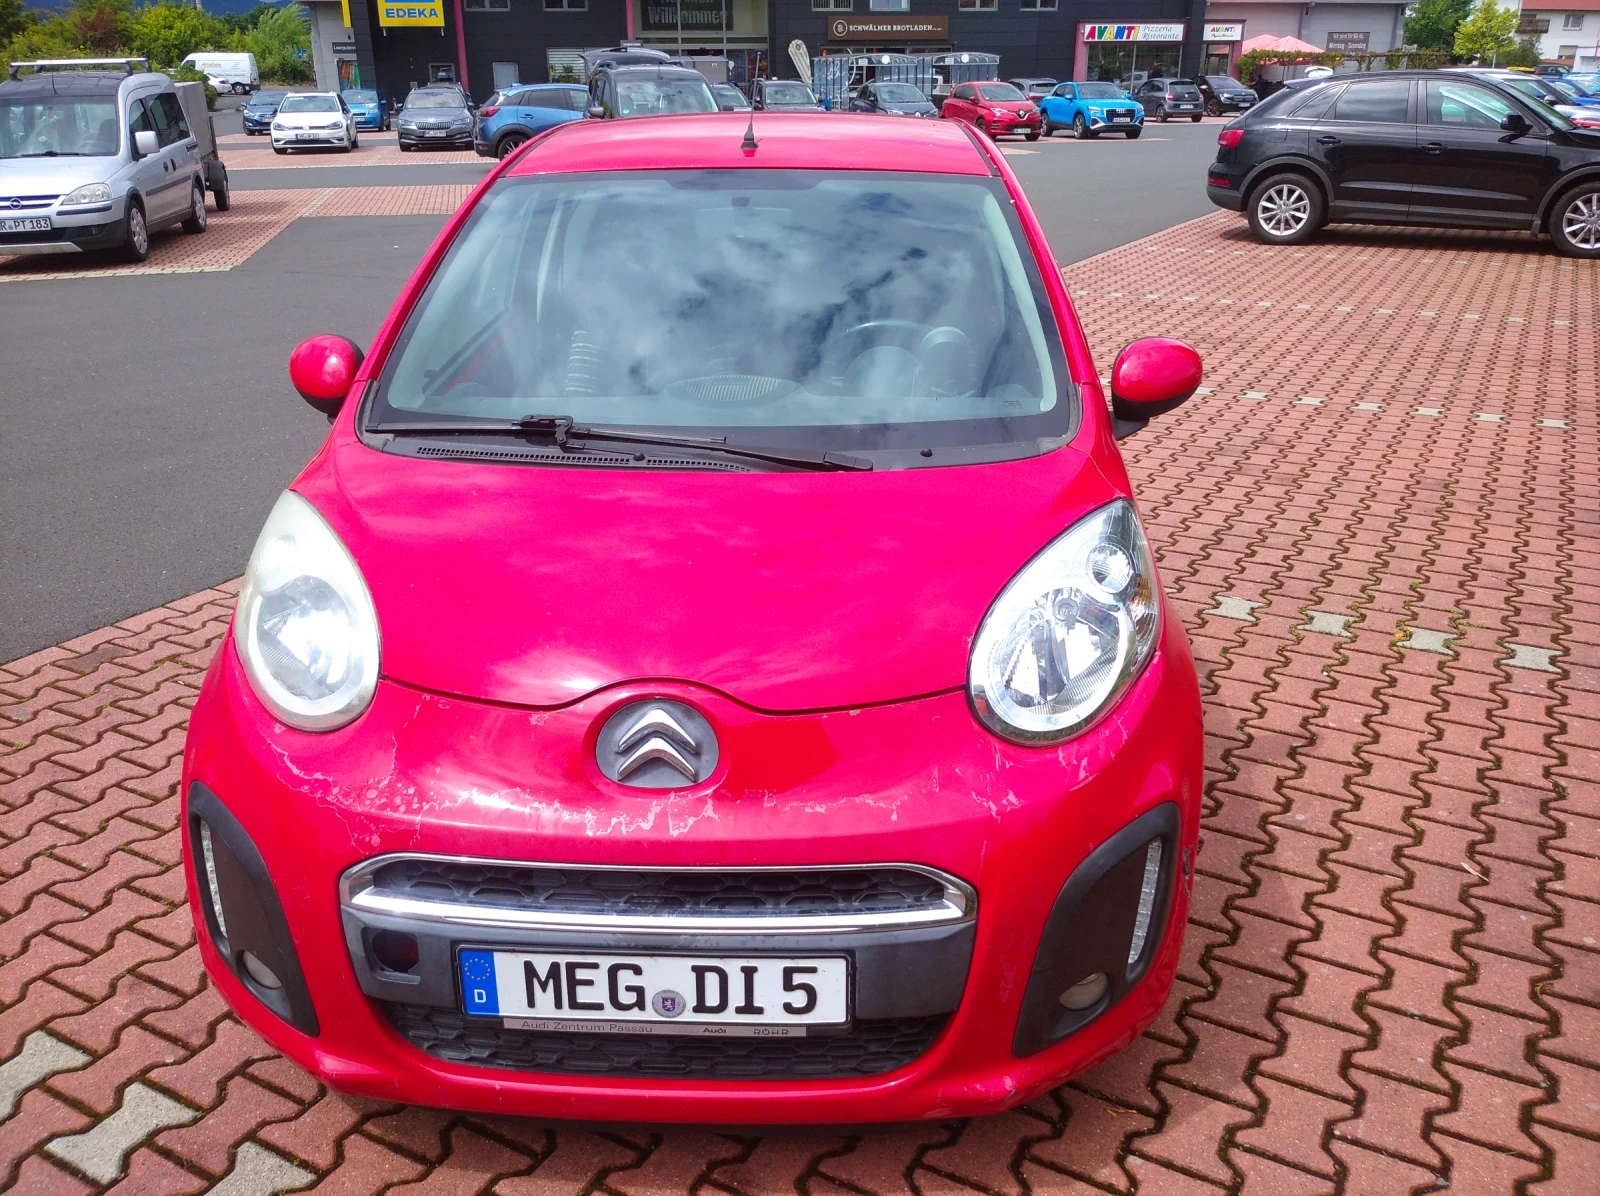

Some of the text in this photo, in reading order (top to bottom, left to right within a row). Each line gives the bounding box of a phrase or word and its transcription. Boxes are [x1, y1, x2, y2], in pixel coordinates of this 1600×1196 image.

[385, 8, 438, 18] EDEKA
[648, 6, 728, 24] Willkommen
[1085, 26, 1140, 40] AVANTI
[13, 220, 26, 230] PT
[29, 219, 49, 229] 183
[523, 960, 646, 1011] MEG
[691, 965, 764, 1014] DI
[782, 966, 818, 1015] 5
[474, 989, 487, 1003] D
[521, 1020, 653, 1033] Audi Zentrum Passau
